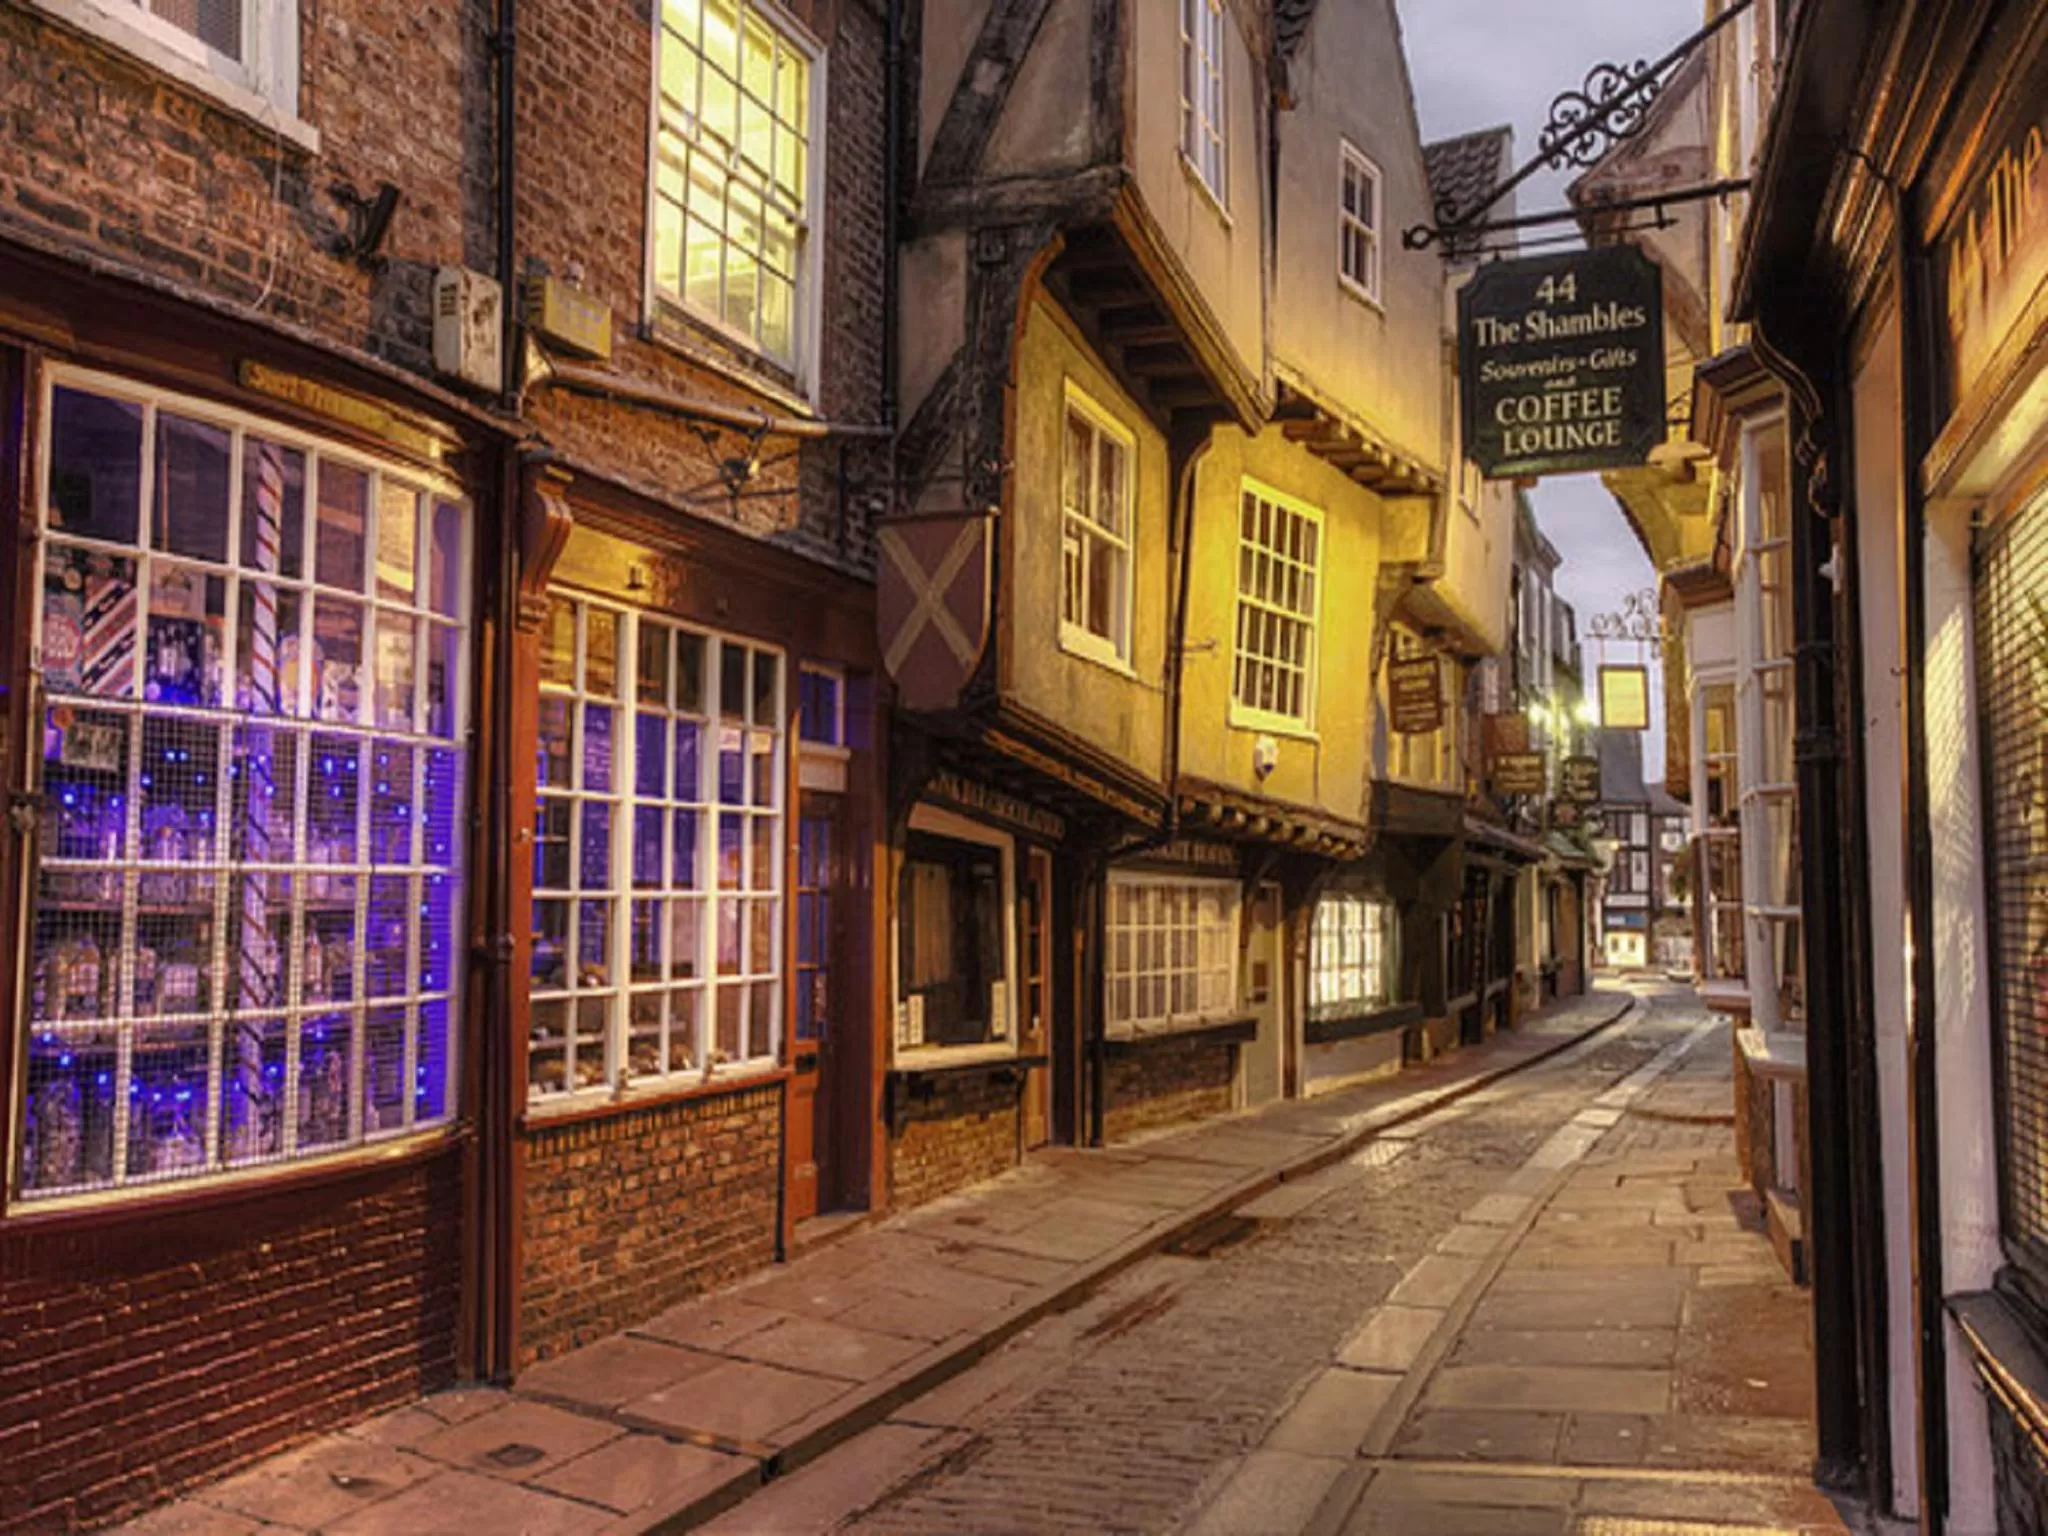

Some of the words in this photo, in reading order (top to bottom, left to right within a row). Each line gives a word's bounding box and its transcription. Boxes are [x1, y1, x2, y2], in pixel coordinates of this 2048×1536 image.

[1535, 271, 1577, 304] 44
[1473, 316, 1520, 347] The
[1525, 301, 1647, 342] Shambles
[1590, 347, 1638, 371] Gifts
[1495, 386, 1623, 426] COFFEE
[1503, 419, 1622, 457] LOUNGE
